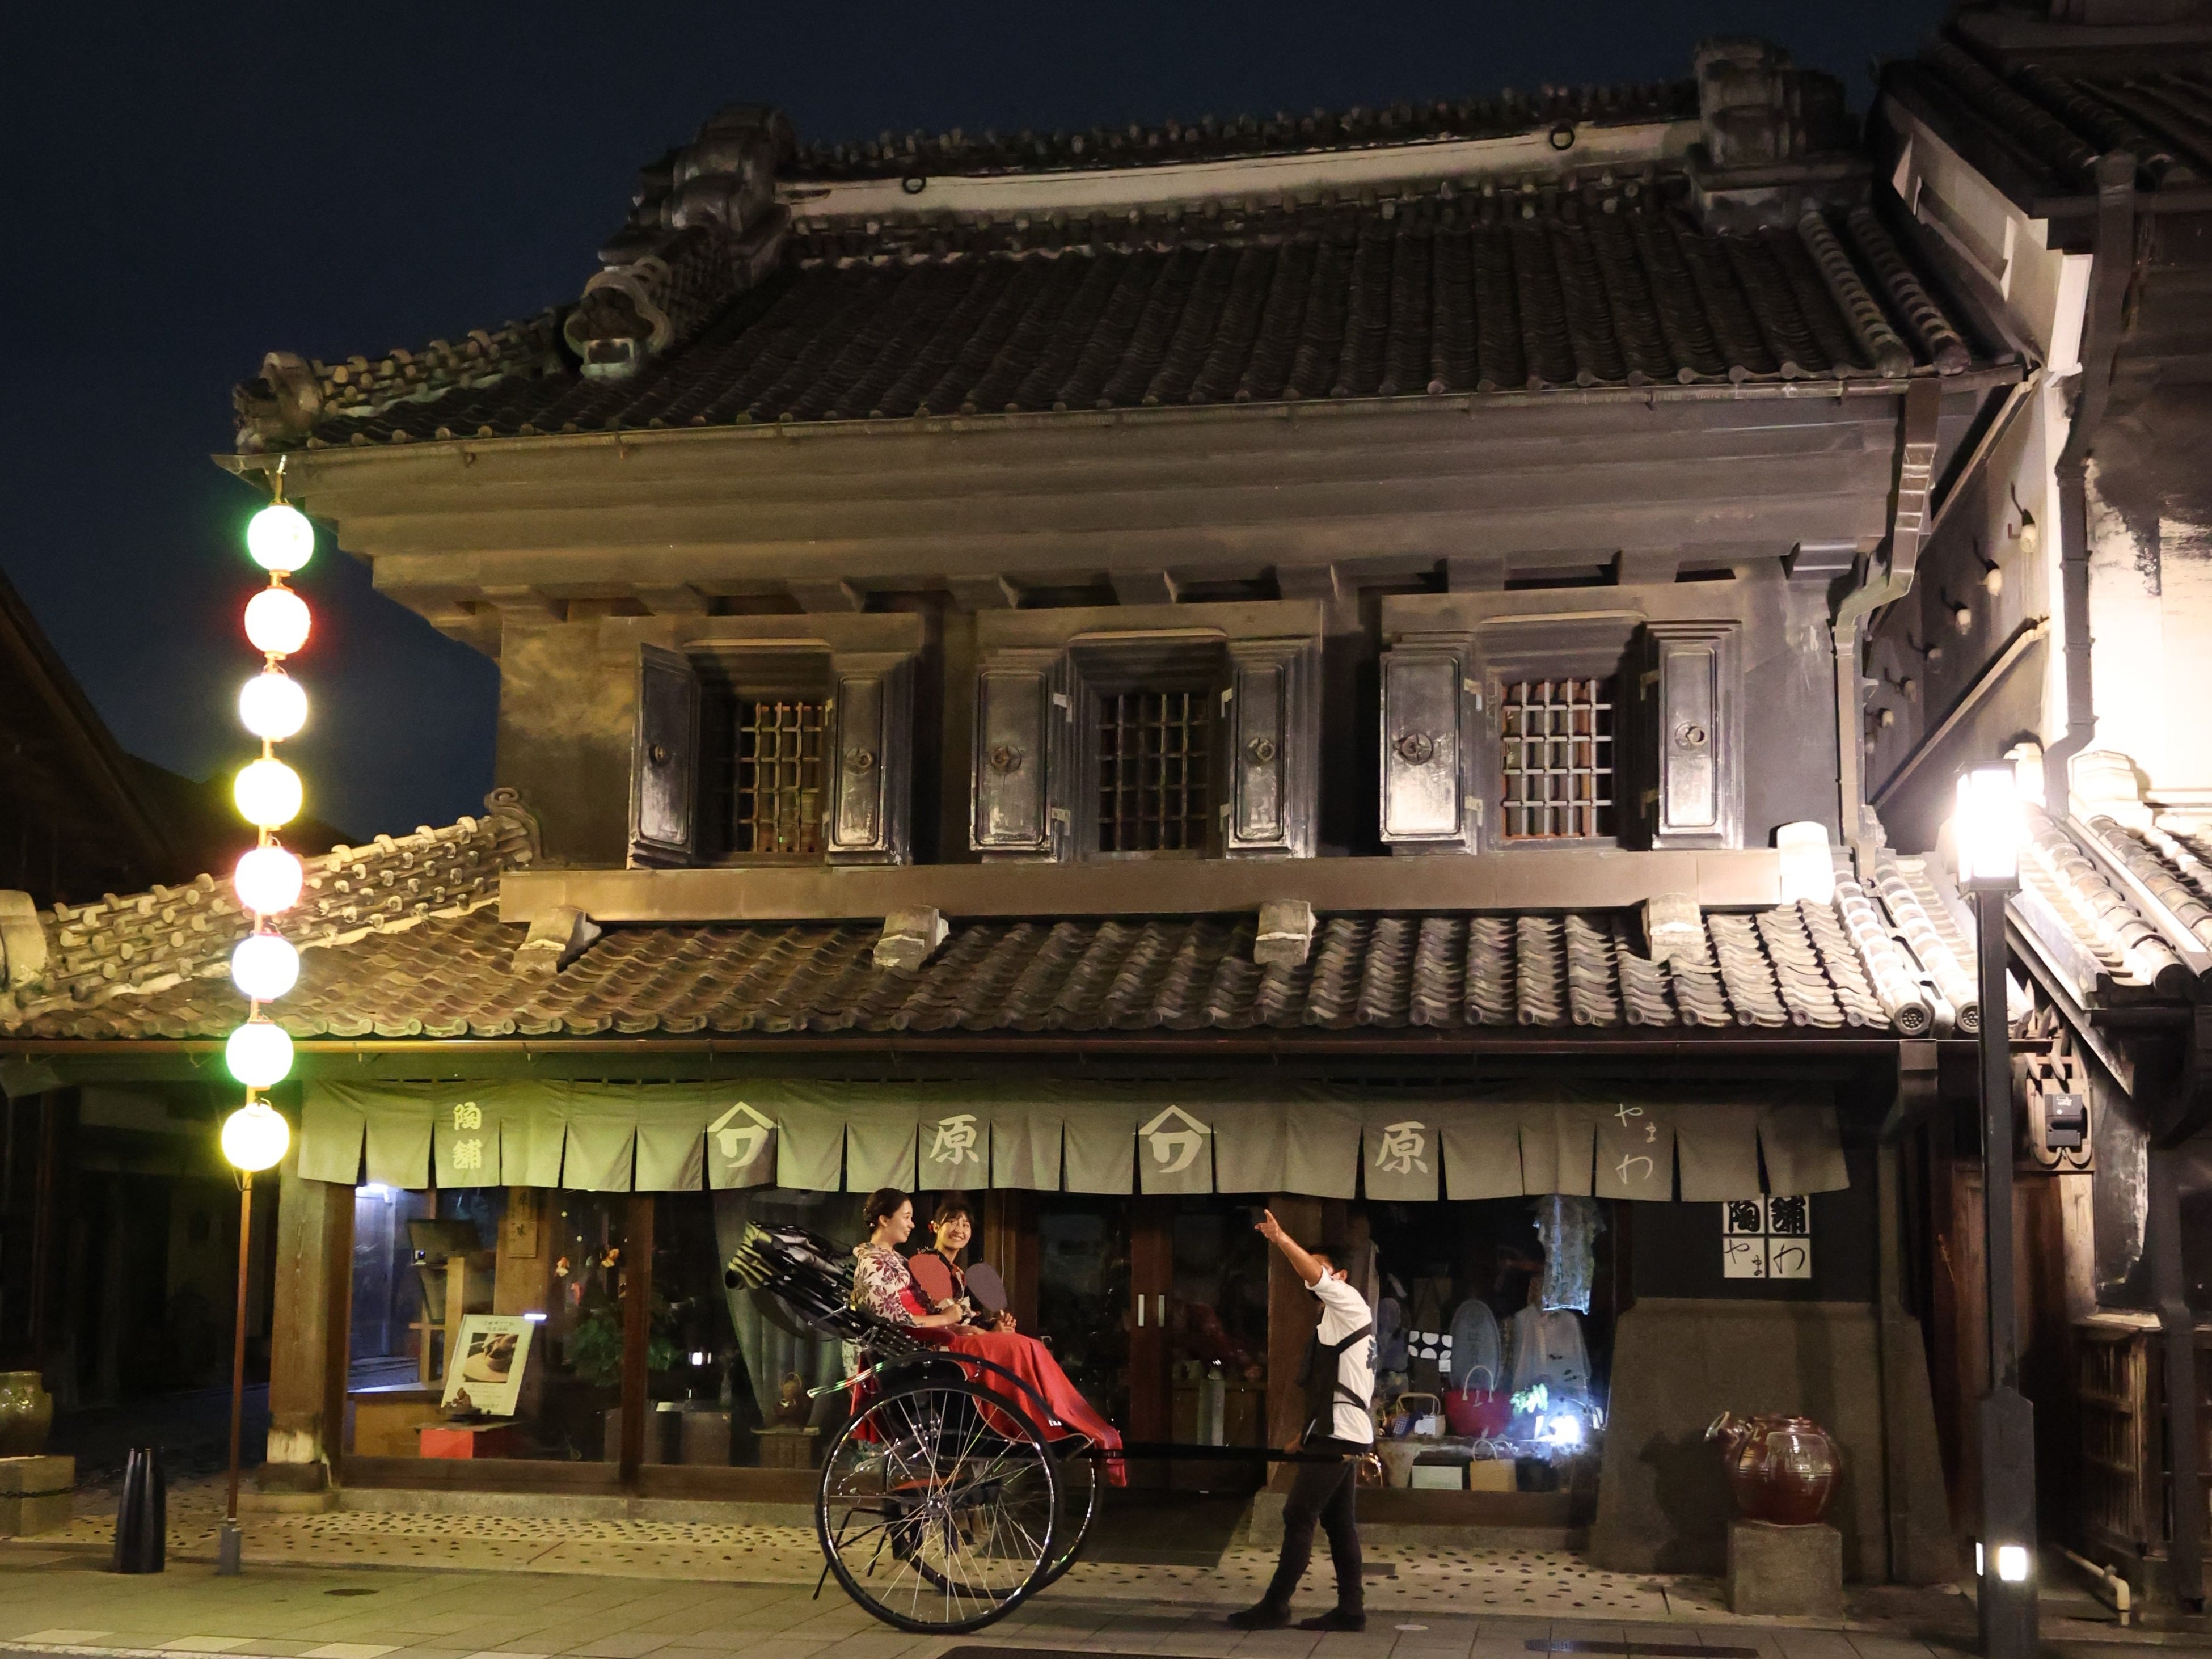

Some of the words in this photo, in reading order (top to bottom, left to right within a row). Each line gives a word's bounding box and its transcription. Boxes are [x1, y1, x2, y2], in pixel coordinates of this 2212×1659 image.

[929, 1114, 980, 1166] 原
[1374, 1121, 1429, 1175] 原
[1614, 1103, 1656, 1185] やまわ
[1724, 1239, 1806, 1277] やまわ
